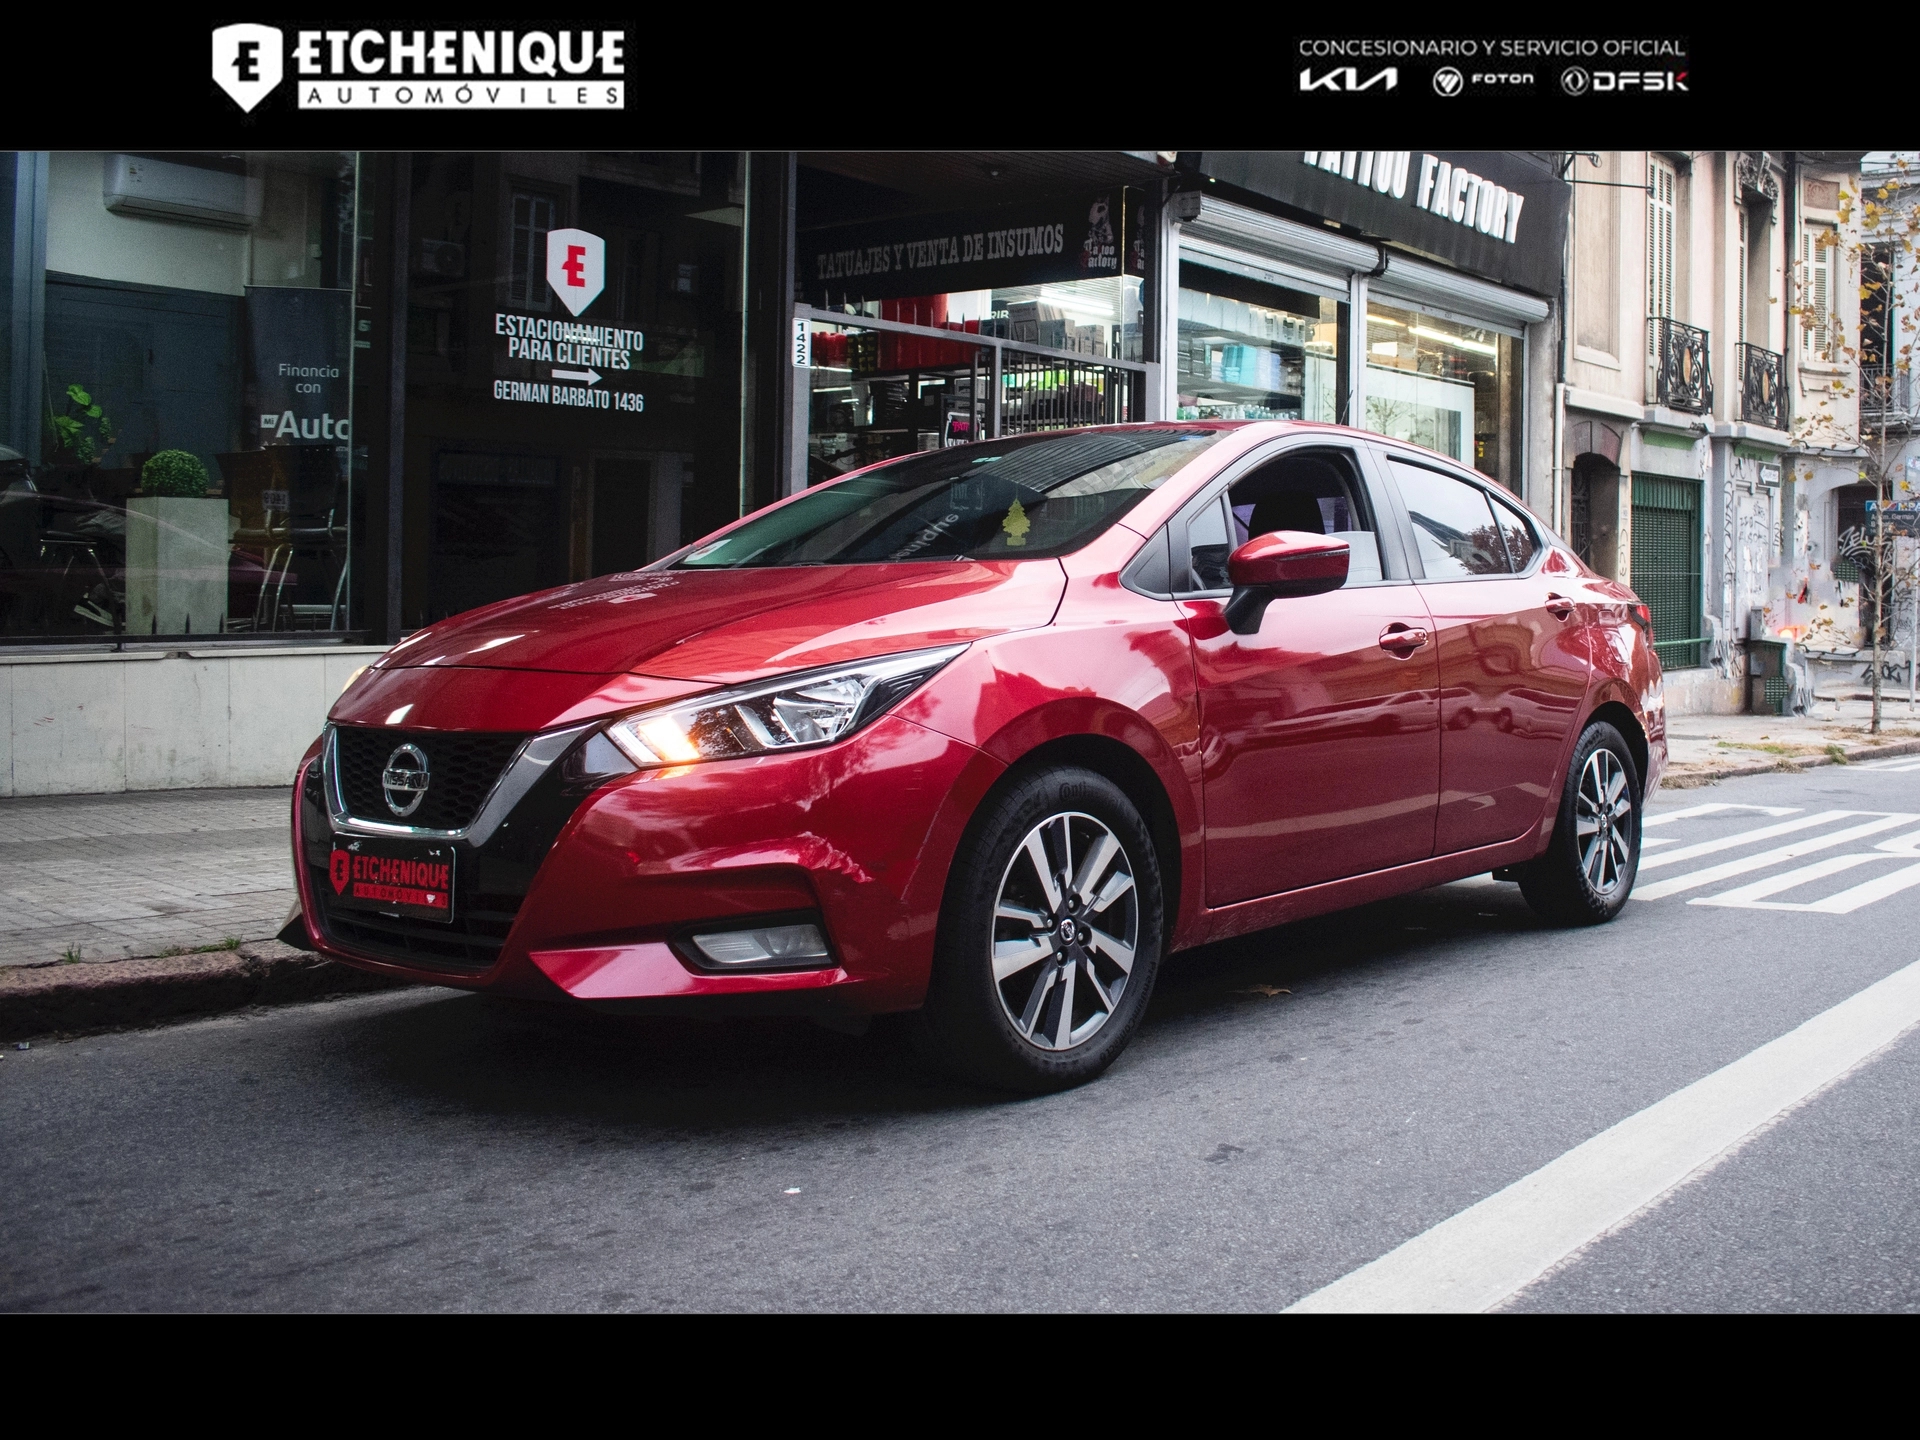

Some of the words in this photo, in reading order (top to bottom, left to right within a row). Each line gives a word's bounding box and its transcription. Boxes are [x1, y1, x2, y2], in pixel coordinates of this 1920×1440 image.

[1416, 153, 1525, 244] FACTORY
[818, 245, 890, 279] TATUAJES
[894, 244, 904, 271] Y
[907, 236, 959, 269] VENTA
[962, 233, 984, 262] DE
[987, 223, 1064, 259] INSUMOS
[495, 313, 644, 351] ESTACIONAMIENTO
[796, 322, 806, 365] 1422
[508, 336, 553, 362] PARA
[556, 342, 631, 370] CLIENTES
[278, 363, 340, 378] Financia
[295, 383, 321, 394] con
[493, 379, 550, 404] GERMAN
[552, 385, 610, 409] BARBATO
[614, 392, 644, 412] 1436
[384, 772, 424, 788] NISSAN
[353, 856, 449, 889] ETCHENIQUE
[355, 887, 447, 906] AUTOMÓVIS
